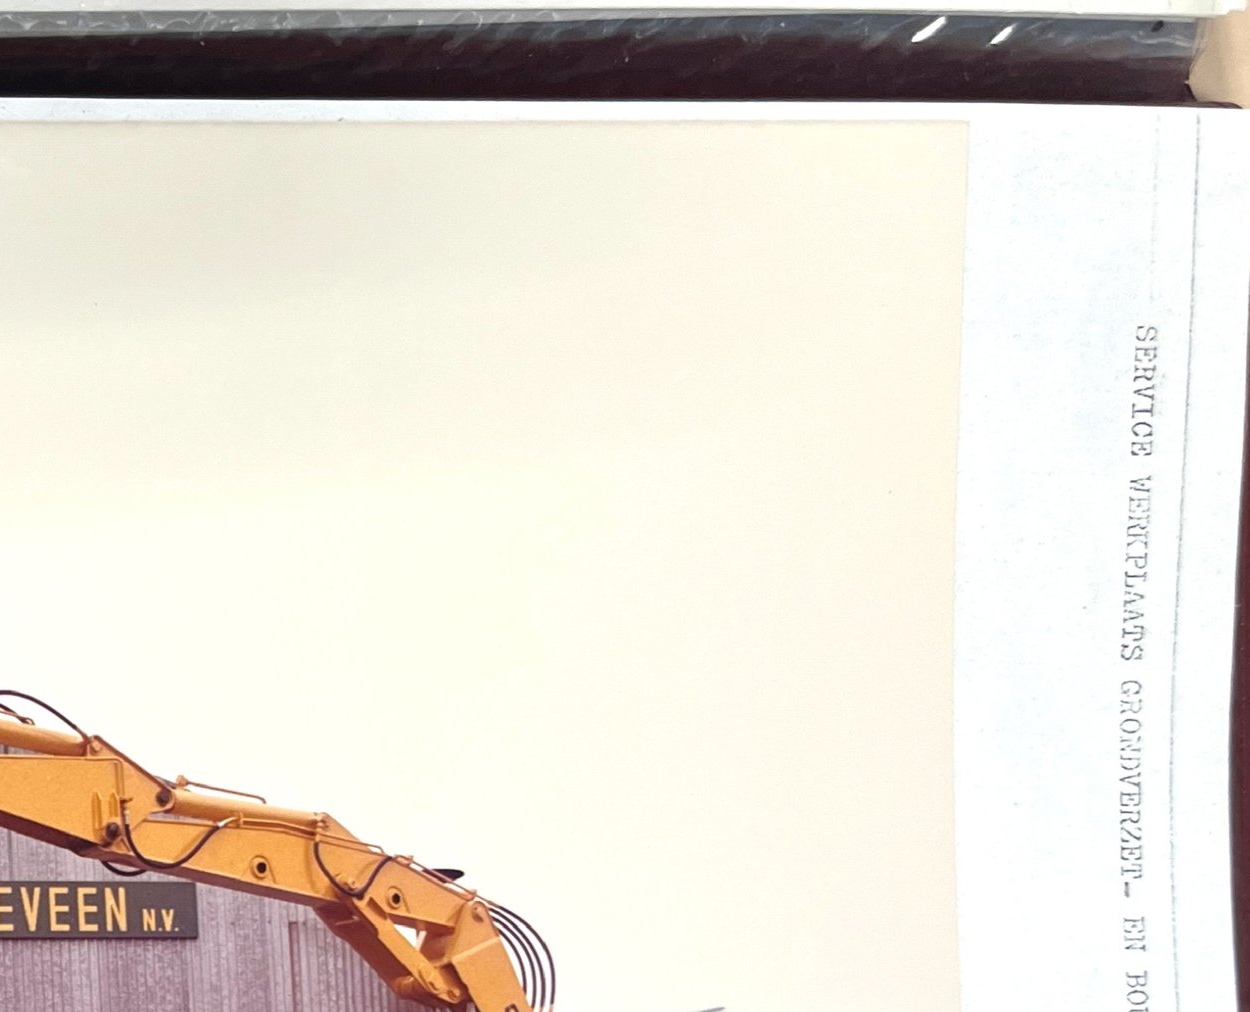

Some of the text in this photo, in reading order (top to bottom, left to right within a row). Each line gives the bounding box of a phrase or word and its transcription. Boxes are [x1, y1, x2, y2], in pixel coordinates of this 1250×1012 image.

[1130, 325, 1159, 457] SERVICE
[1120, 475, 1152, 662] WERKPLAATS
[142, 908, 179, 933] N.V.
[1122, 916, 1147, 952] EN
